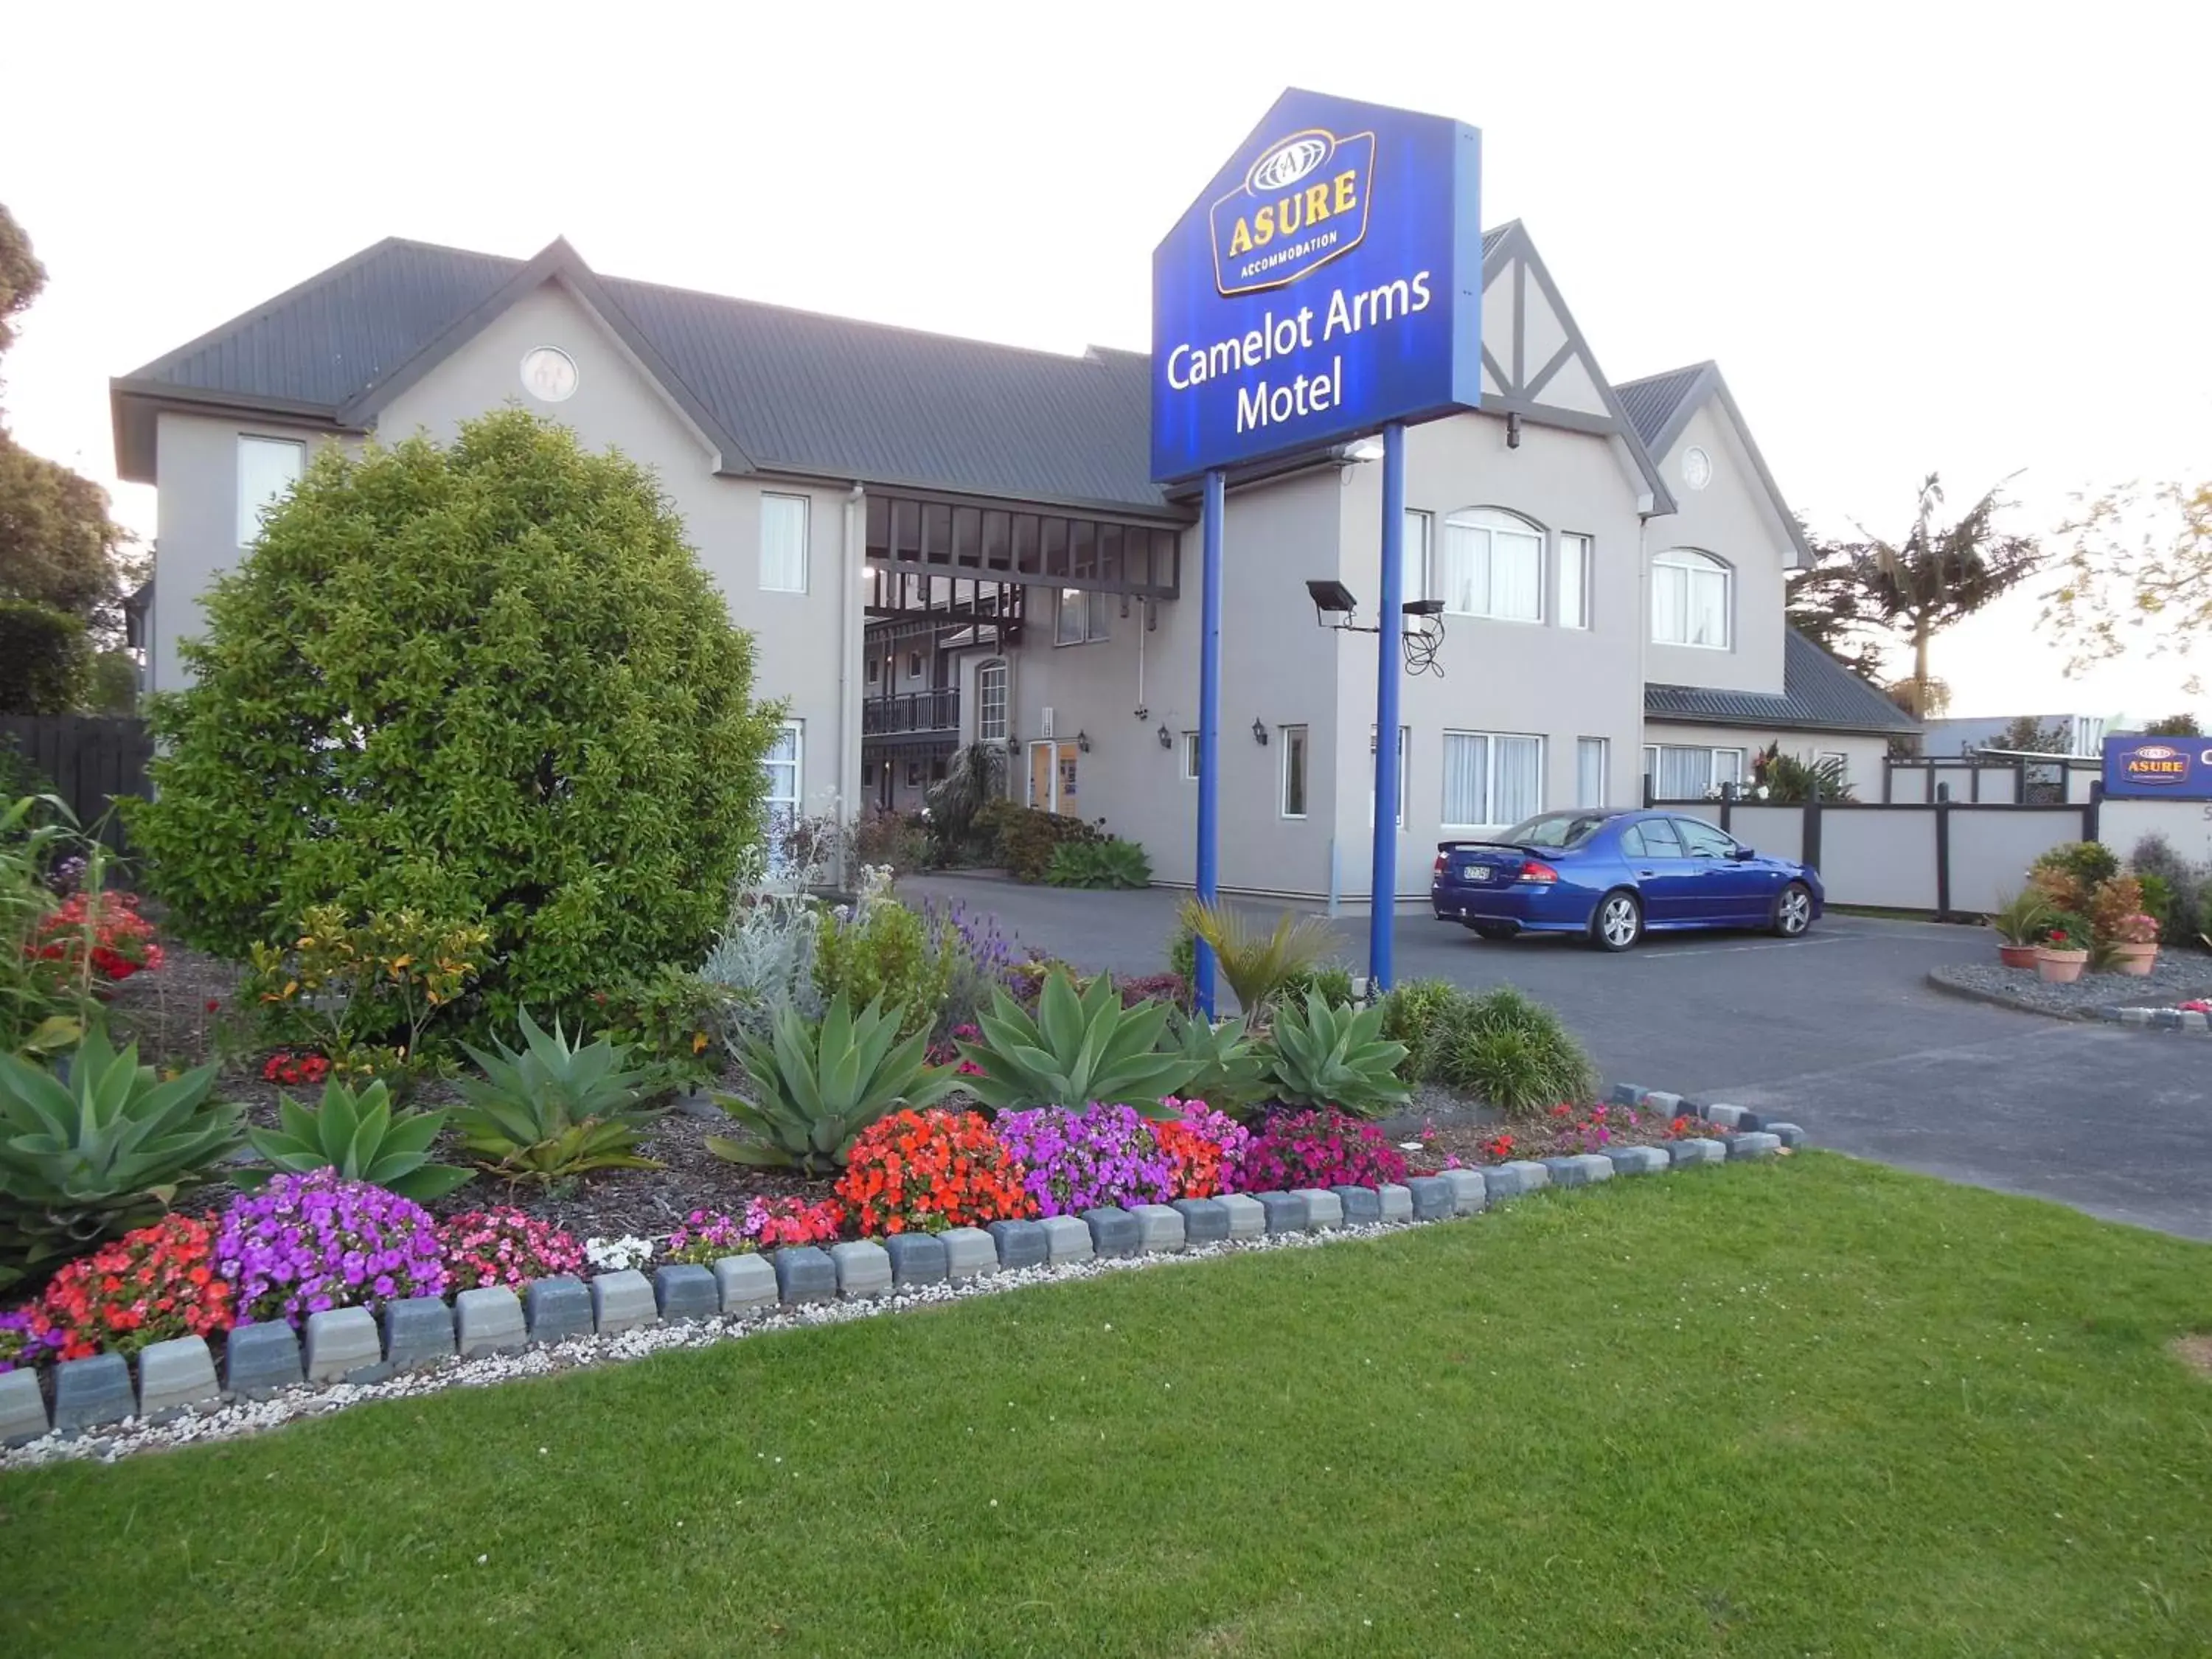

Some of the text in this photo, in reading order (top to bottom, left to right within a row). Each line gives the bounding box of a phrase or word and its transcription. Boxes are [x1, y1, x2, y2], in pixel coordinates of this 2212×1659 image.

[1229, 170, 1357, 258] ASURE
[1241, 231, 1338, 279] ACCOMMODATION
[1167, 269, 1432, 390] Camelot Arms
[1236, 356, 1342, 434] Motel
[2129, 760, 2183, 772] ASURE
